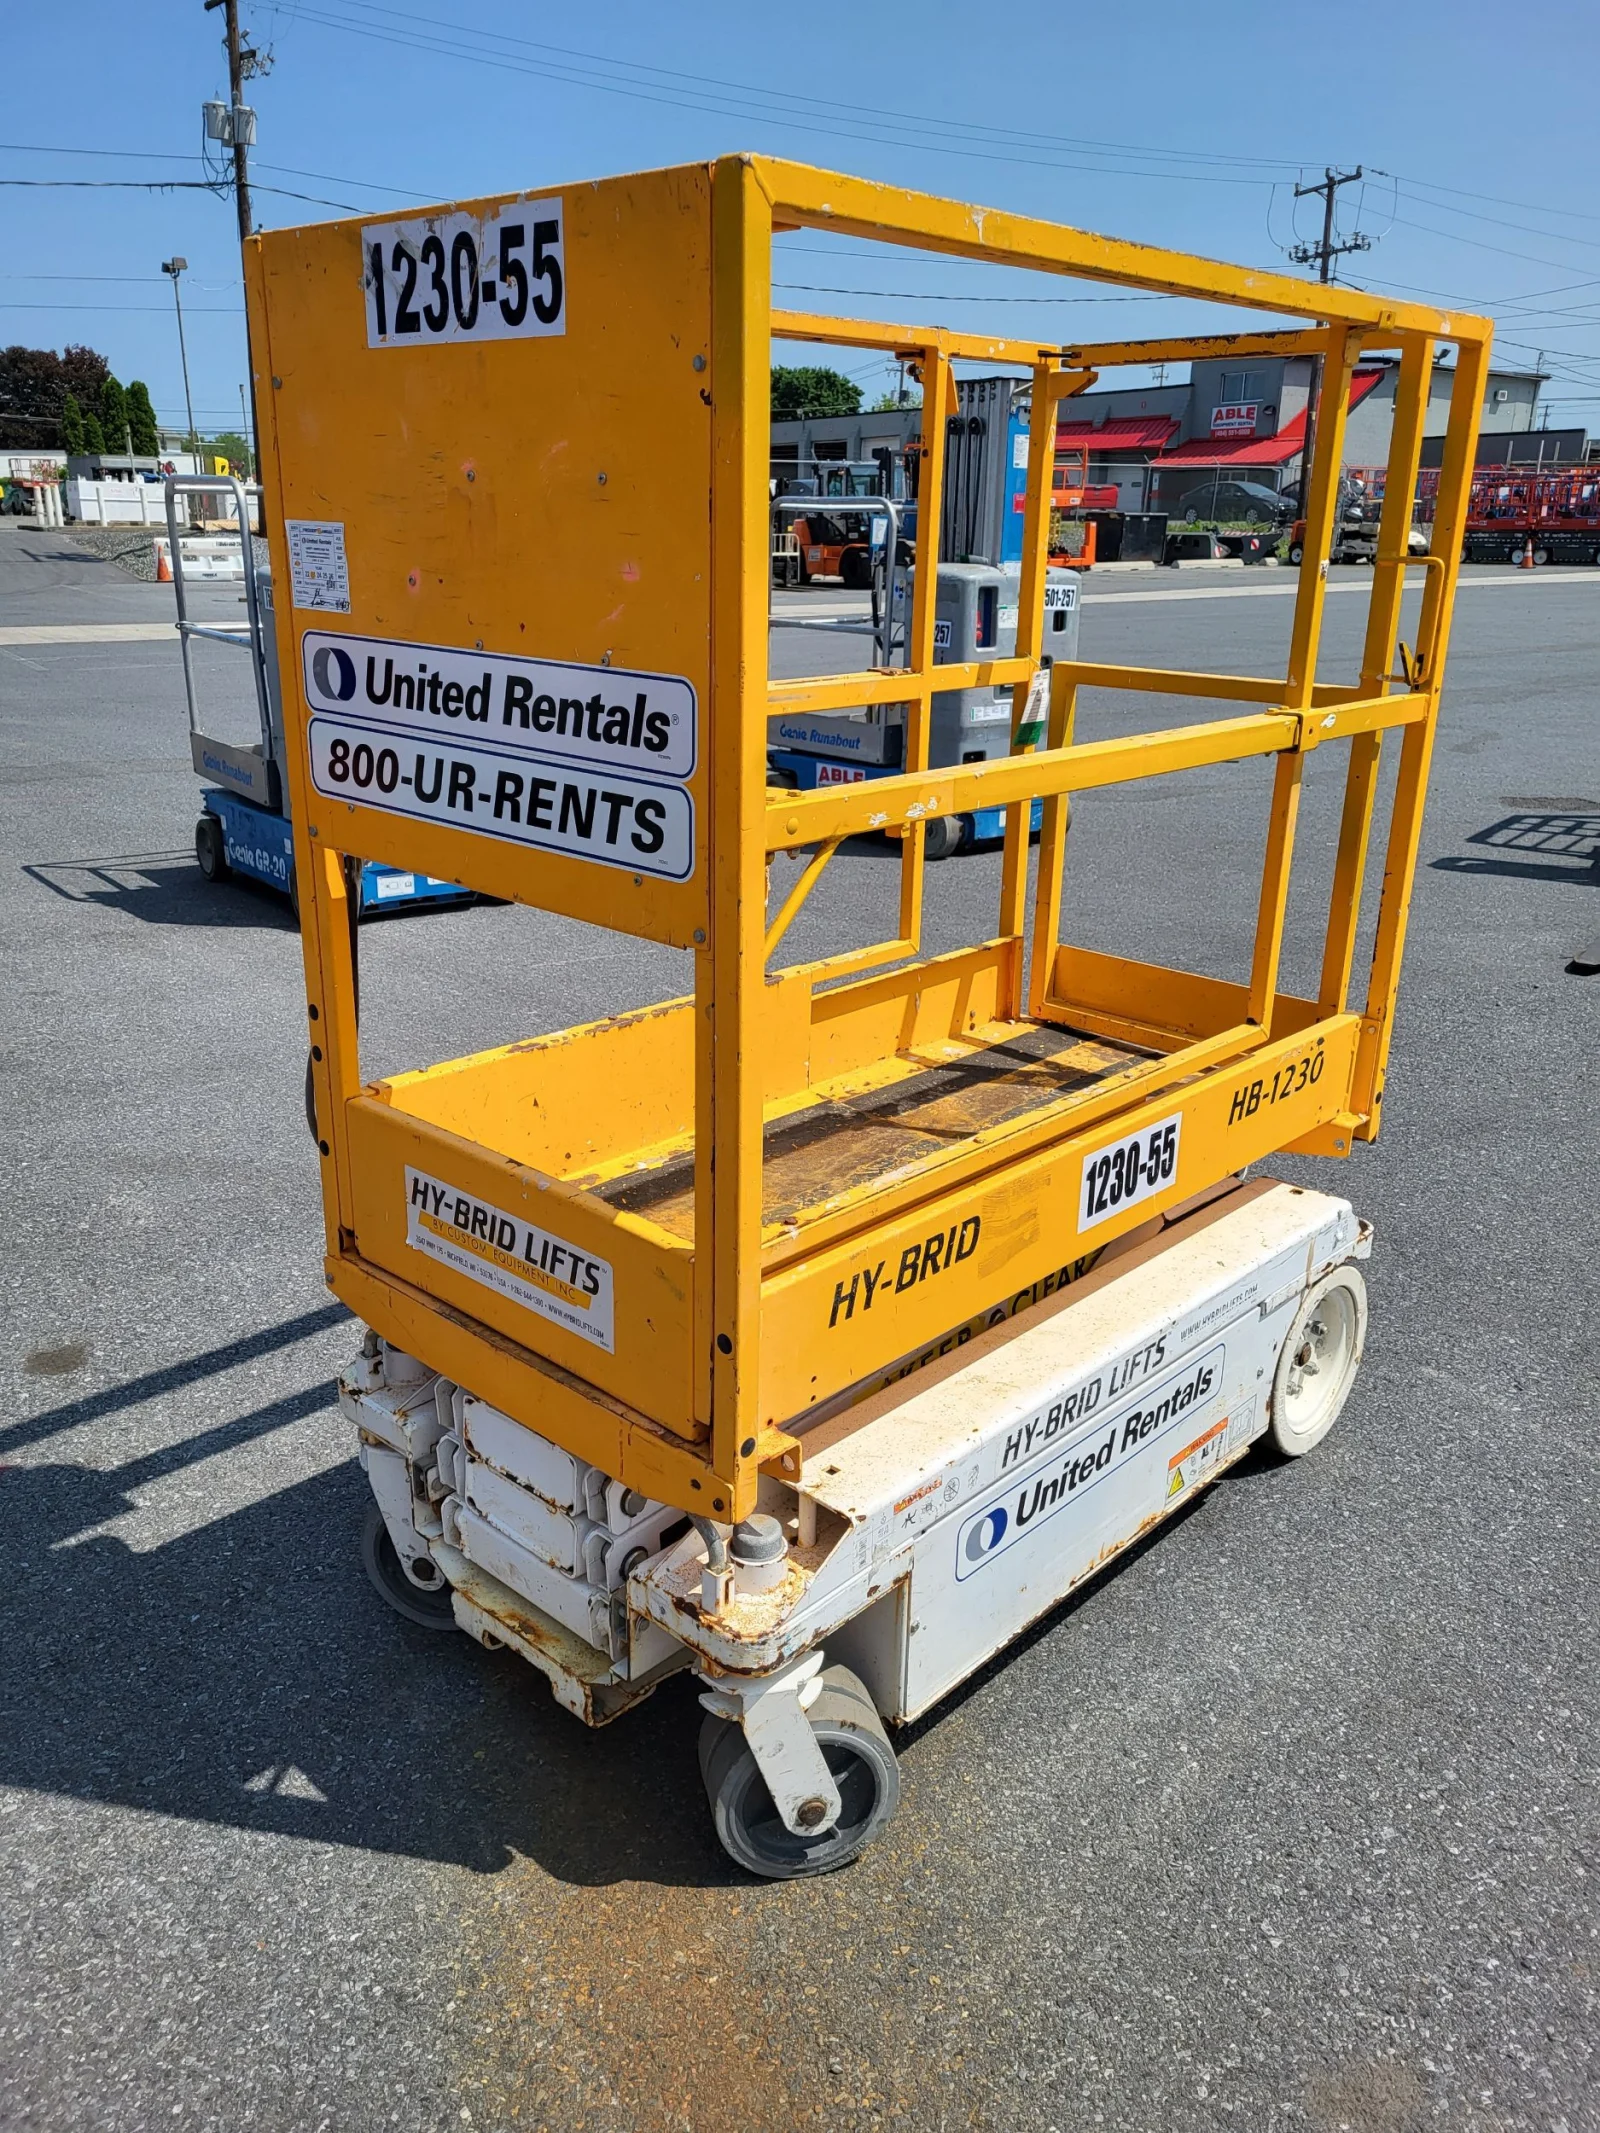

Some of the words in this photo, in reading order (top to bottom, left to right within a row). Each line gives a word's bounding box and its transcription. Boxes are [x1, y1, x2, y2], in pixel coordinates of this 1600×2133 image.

[364, 219, 563, 335] 1230-55
[1214, 407, 1256, 422] ABLE
[163, 541, 188, 549] AE
[1044, 589, 1075, 608] 501-257
[365, 655, 492, 723] United
[203, 750, 221, 773] Genie
[780, 722, 807, 741] Genie
[809, 729, 861, 750] Runabout
[818, 765, 864, 783] ABLE
[328, 738, 667, 854] 800-UR-RENTS
[228, 836, 256, 868] Genie
[255, 848, 286, 881] GR-20
[1228, 1050, 1324, 1126] HB-1230
[1085, 1122, 1177, 1218] 1230-55
[411, 1176, 517, 1253] HY-BRID
[524, 1231, 601, 1296] LIFTS
[433, 1217, 444, 1232] BY
[447, 1226, 487, 1254] CUSTOM
[493, 1248, 550, 1286] EQUIPMENT
[555, 1280, 576, 1300] INC
[828, 1215, 981, 1329] HY-BRID
[1002, 1385, 1101, 1469] HY-BRID
[1108, 1336, 1167, 1400] LIFTS
[1016, 1427, 1117, 1526] United
